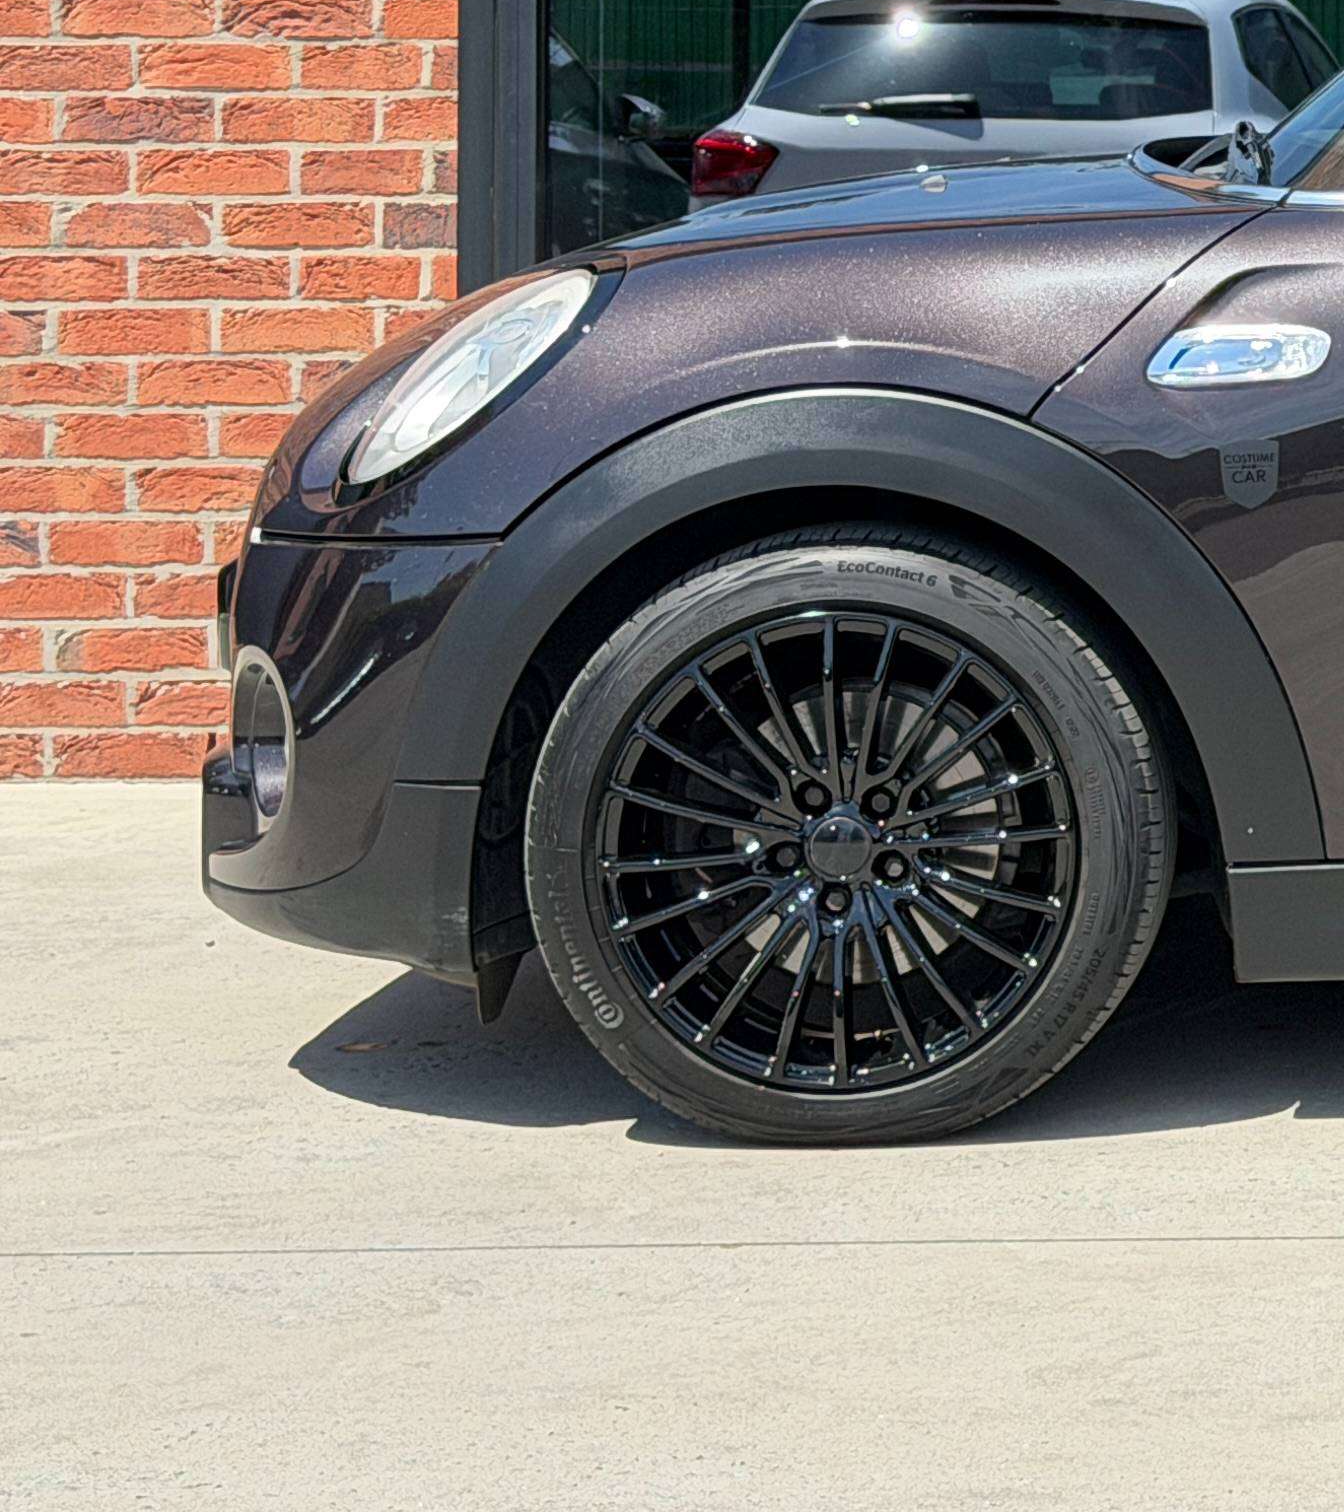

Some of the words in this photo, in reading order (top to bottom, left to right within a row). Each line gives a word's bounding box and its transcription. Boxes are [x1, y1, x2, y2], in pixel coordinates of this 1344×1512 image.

[1223, 453, 1275, 465] COSTUME
[1231, 469, 1266, 484] CAR
[836, 560, 924, 583] EcoContact
[925, 574, 938, 587] 6
